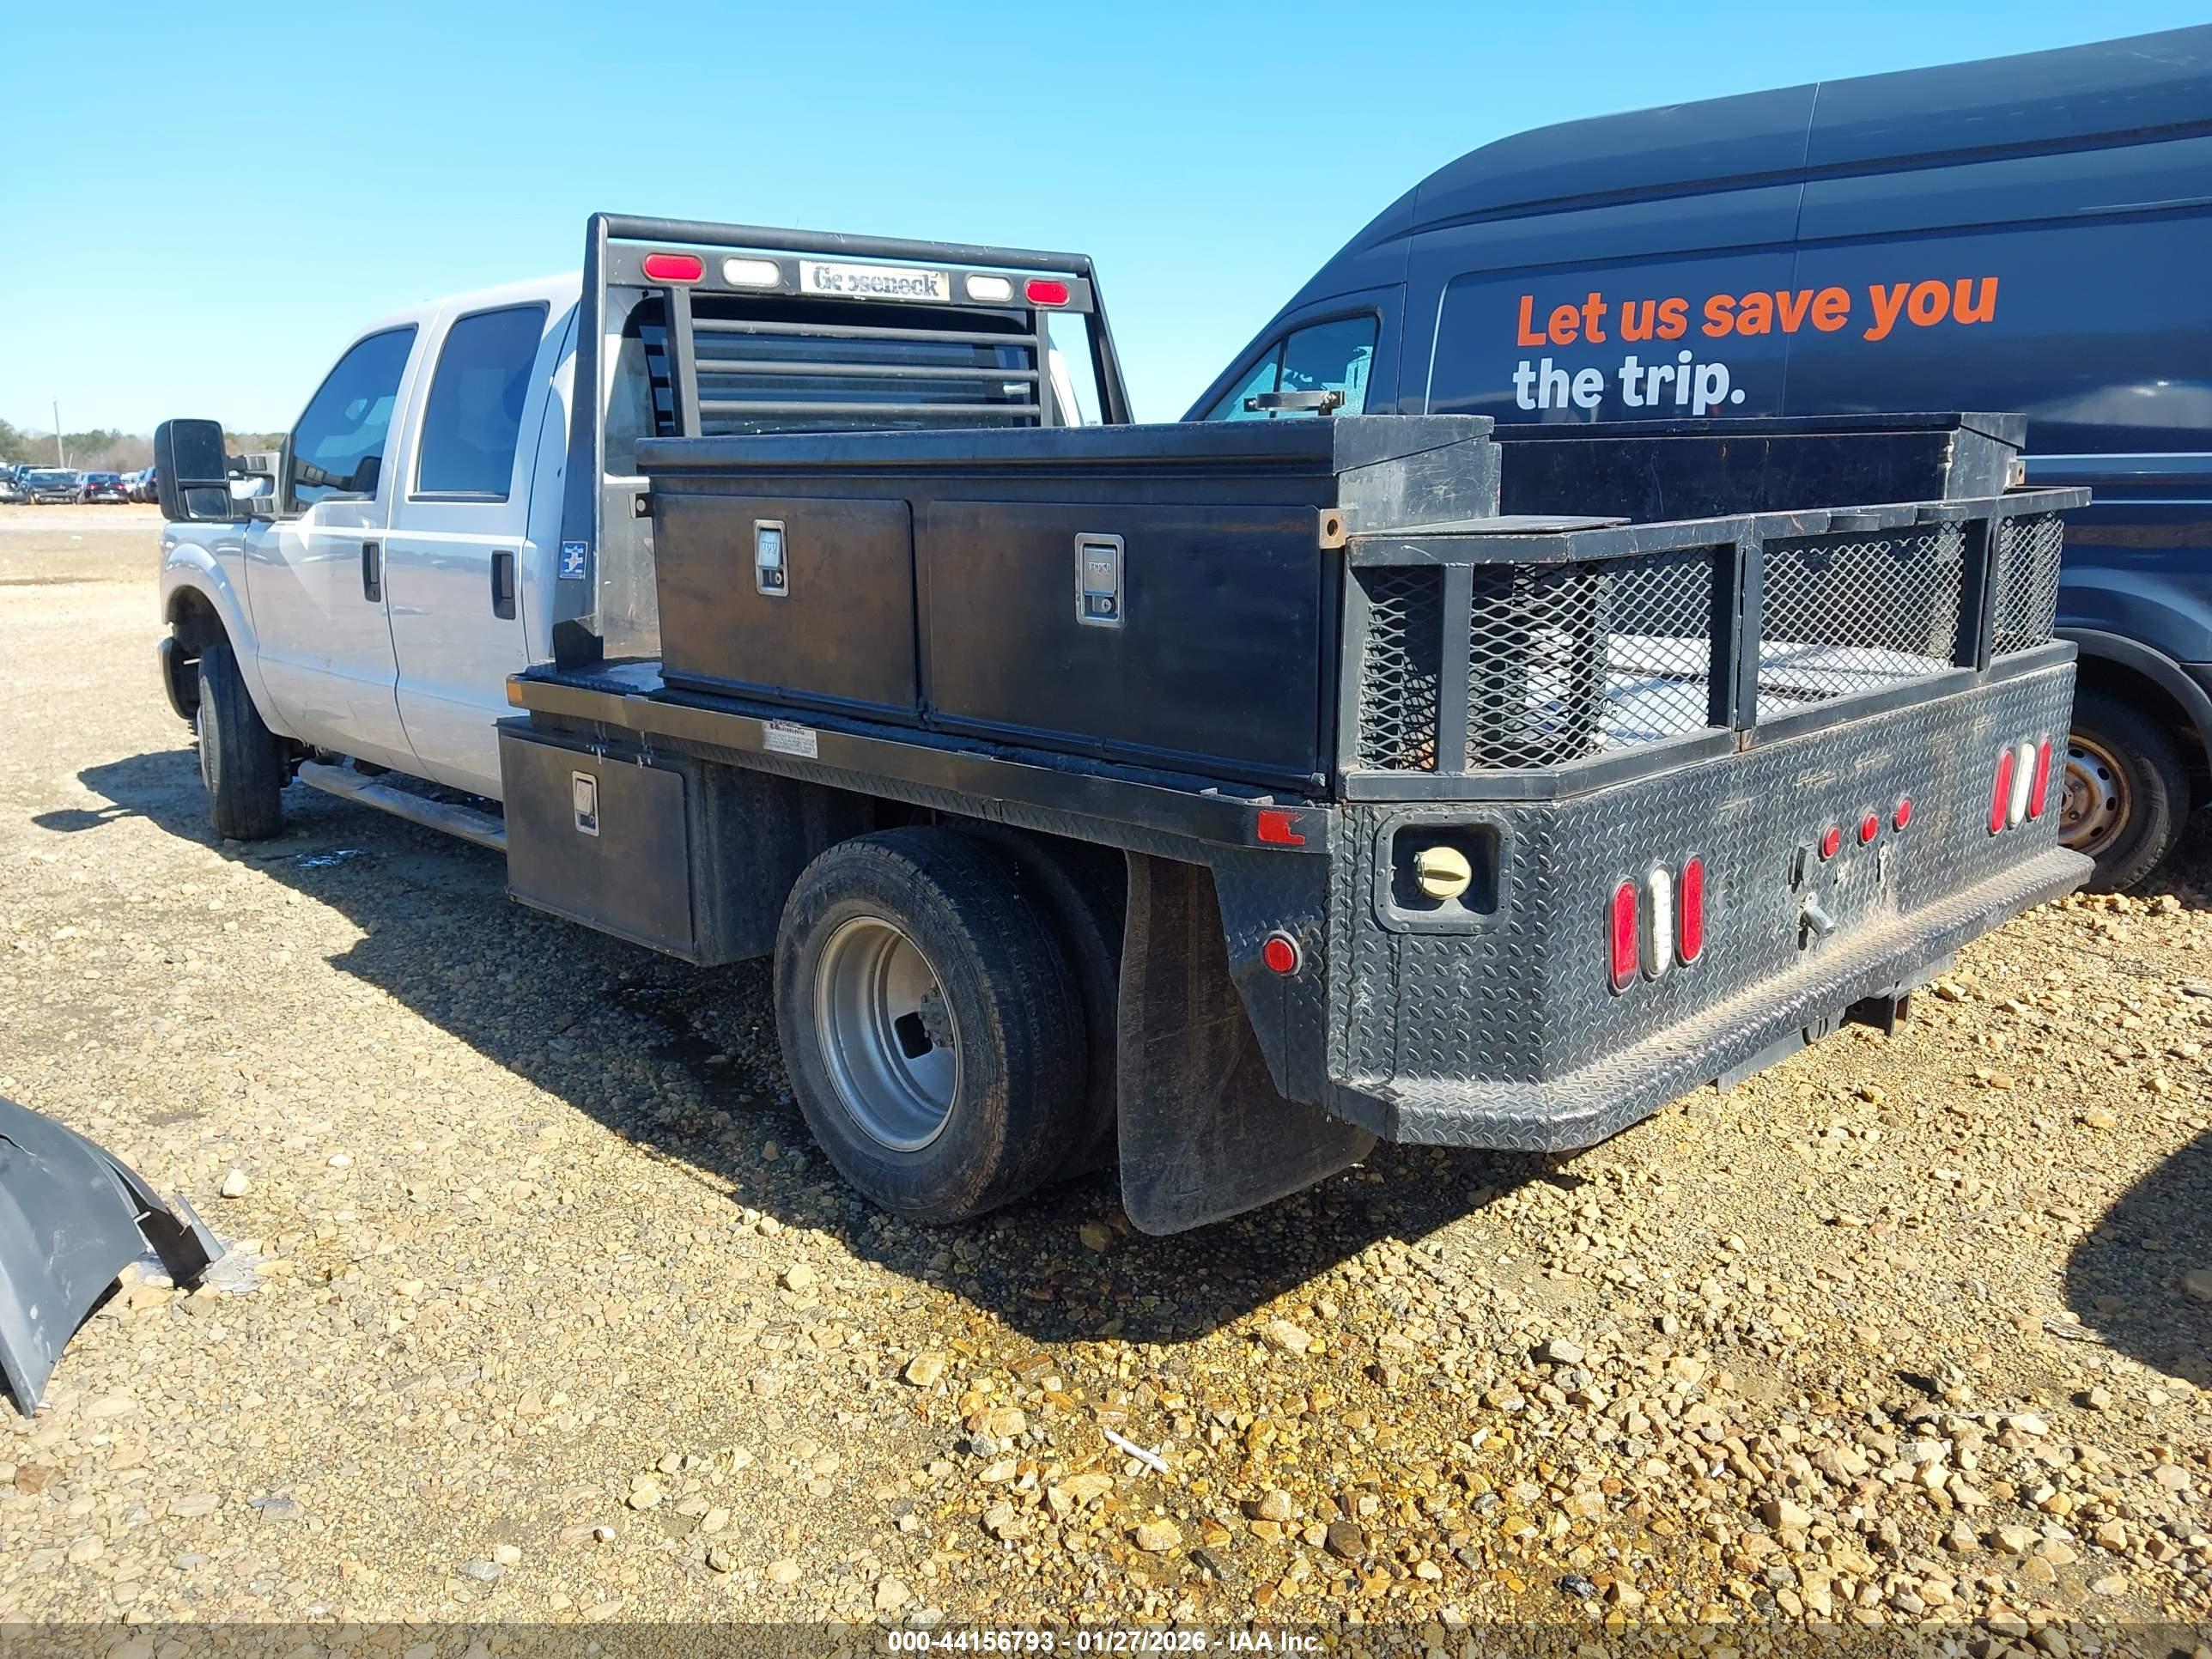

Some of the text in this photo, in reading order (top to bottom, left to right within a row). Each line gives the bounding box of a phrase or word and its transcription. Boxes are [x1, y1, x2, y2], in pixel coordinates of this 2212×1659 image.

[1517, 277, 1998, 346] Let us save you
[1512, 349, 1746, 416] the trip.
